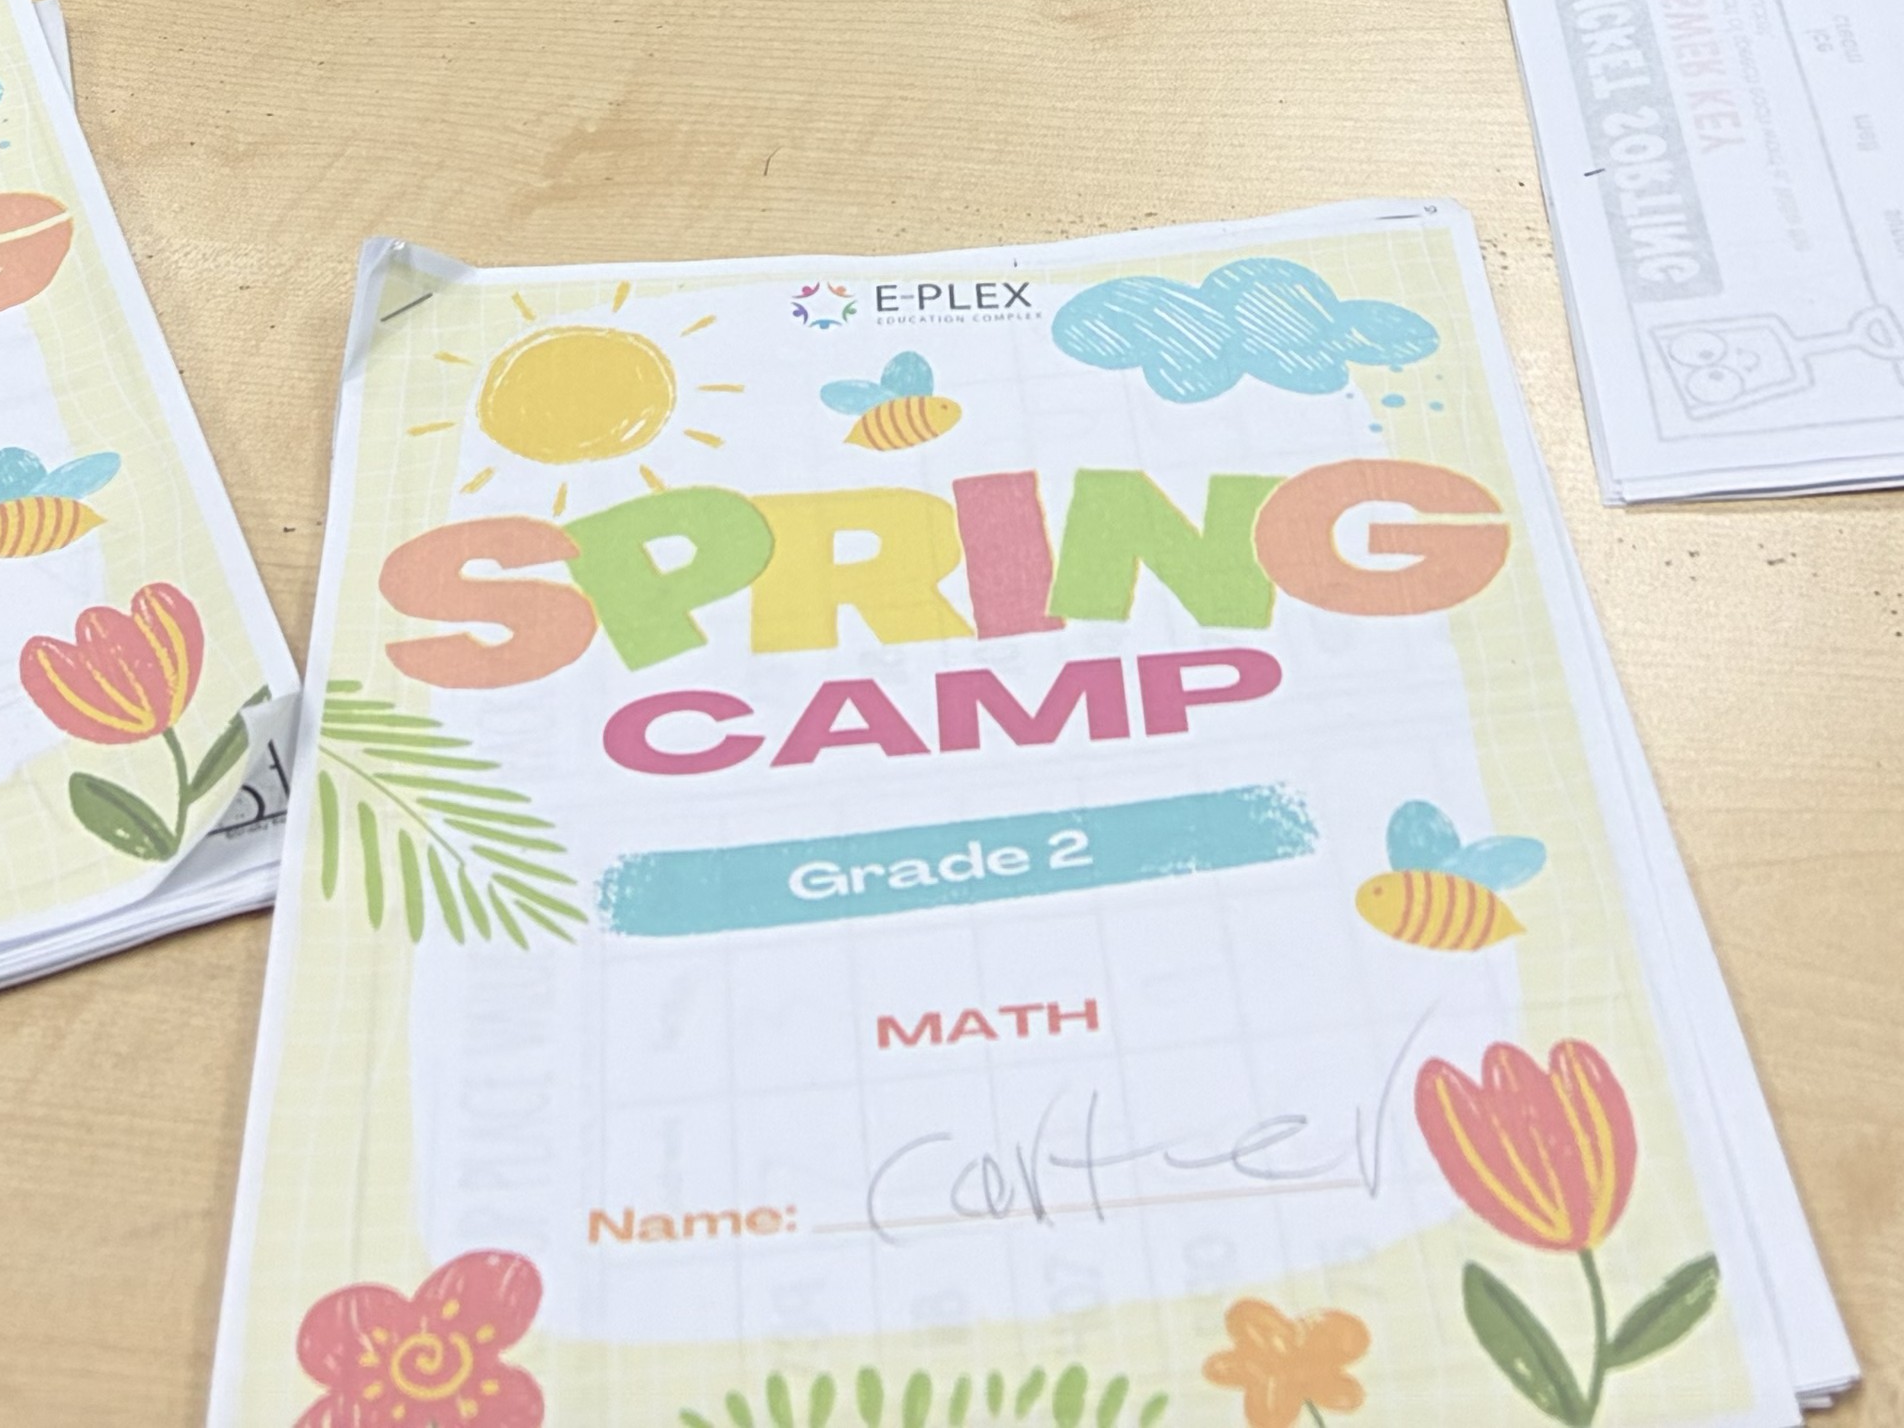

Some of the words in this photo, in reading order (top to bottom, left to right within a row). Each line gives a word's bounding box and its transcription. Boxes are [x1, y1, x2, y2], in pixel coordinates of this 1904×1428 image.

[875, 280, 1032, 313] E-PLEX
[876, 314, 965, 326] EDUCATION
[972, 311, 1043, 324] COMPLEX
[377, 459, 1511, 689] SPRING
[601, 647, 1284, 776] CAMP
[787, 838, 1036, 902] Grade
[1045, 828, 1096, 874] 2
[877, 999, 1099, 1050] MATH
[587, 1203, 797, 1245] Name:
